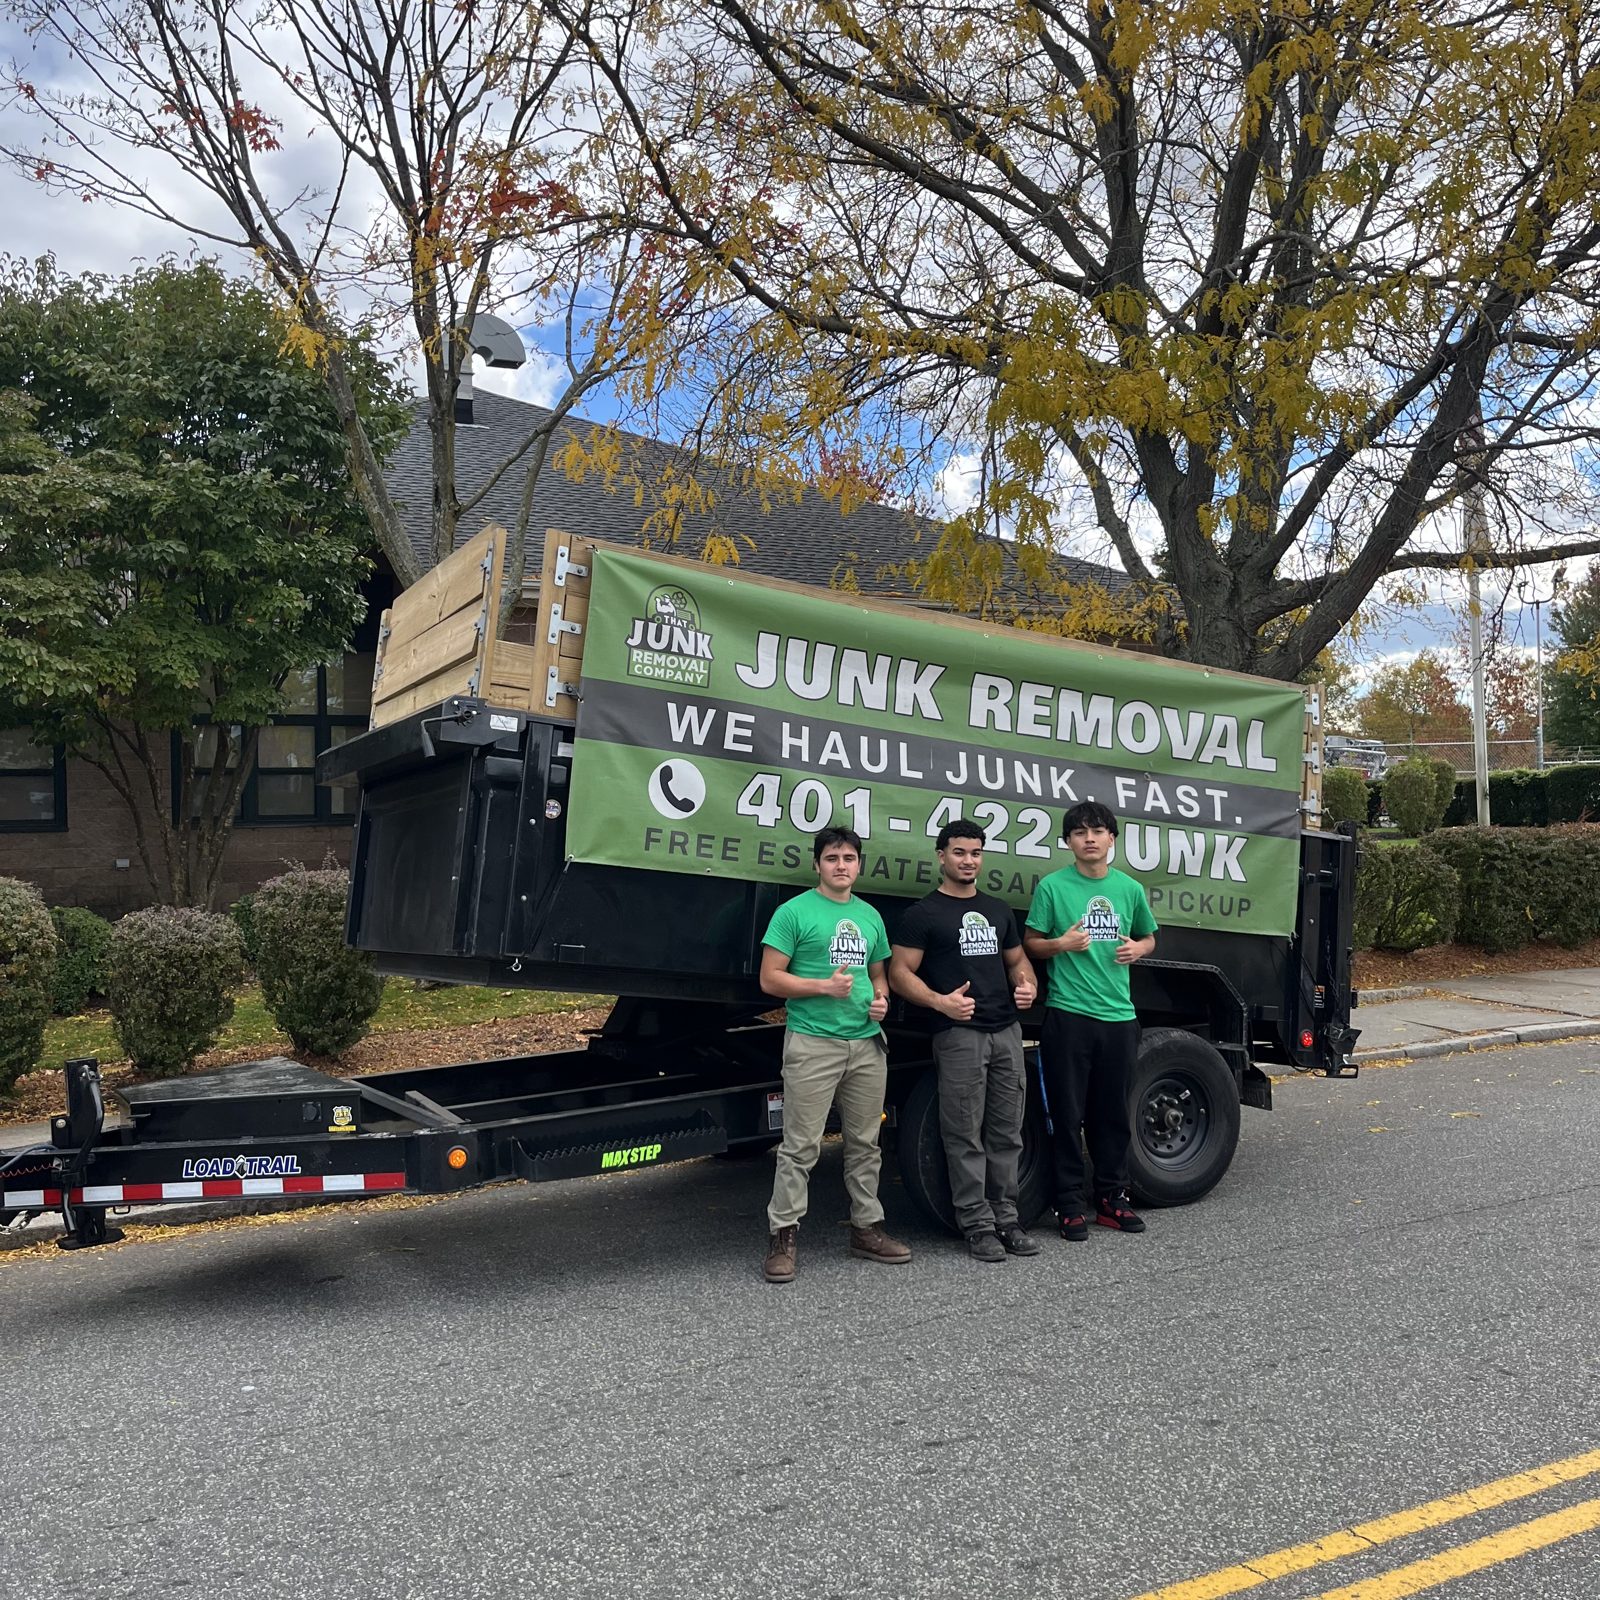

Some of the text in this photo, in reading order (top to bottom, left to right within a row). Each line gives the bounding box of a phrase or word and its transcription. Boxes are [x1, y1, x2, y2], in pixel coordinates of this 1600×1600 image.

[663, 614, 688, 628] THAT
[626, 619, 714, 660] JUNK
[632, 649, 708, 674] REMOVAL
[634, 664, 704, 684] COMPANY
[735, 631, 1277, 772] JUNK REMOVAL
[666, 702, 1243, 825] WE HAUL JUNK. FAST.
[644, 827, 741, 862] FREE
[1149, 887, 1252, 918] PICKUP
[1082, 914, 1119, 928] JUNK
[830, 937, 867, 952] JUNK
[961, 928, 998, 943] JUNK
[962, 941, 996, 950] REMOVAL
[832, 951, 864, 960] REMOVAL
[182, 1155, 302, 1178] LOAD TRAIL
[601, 1144, 662, 1168] MAXSTEP
